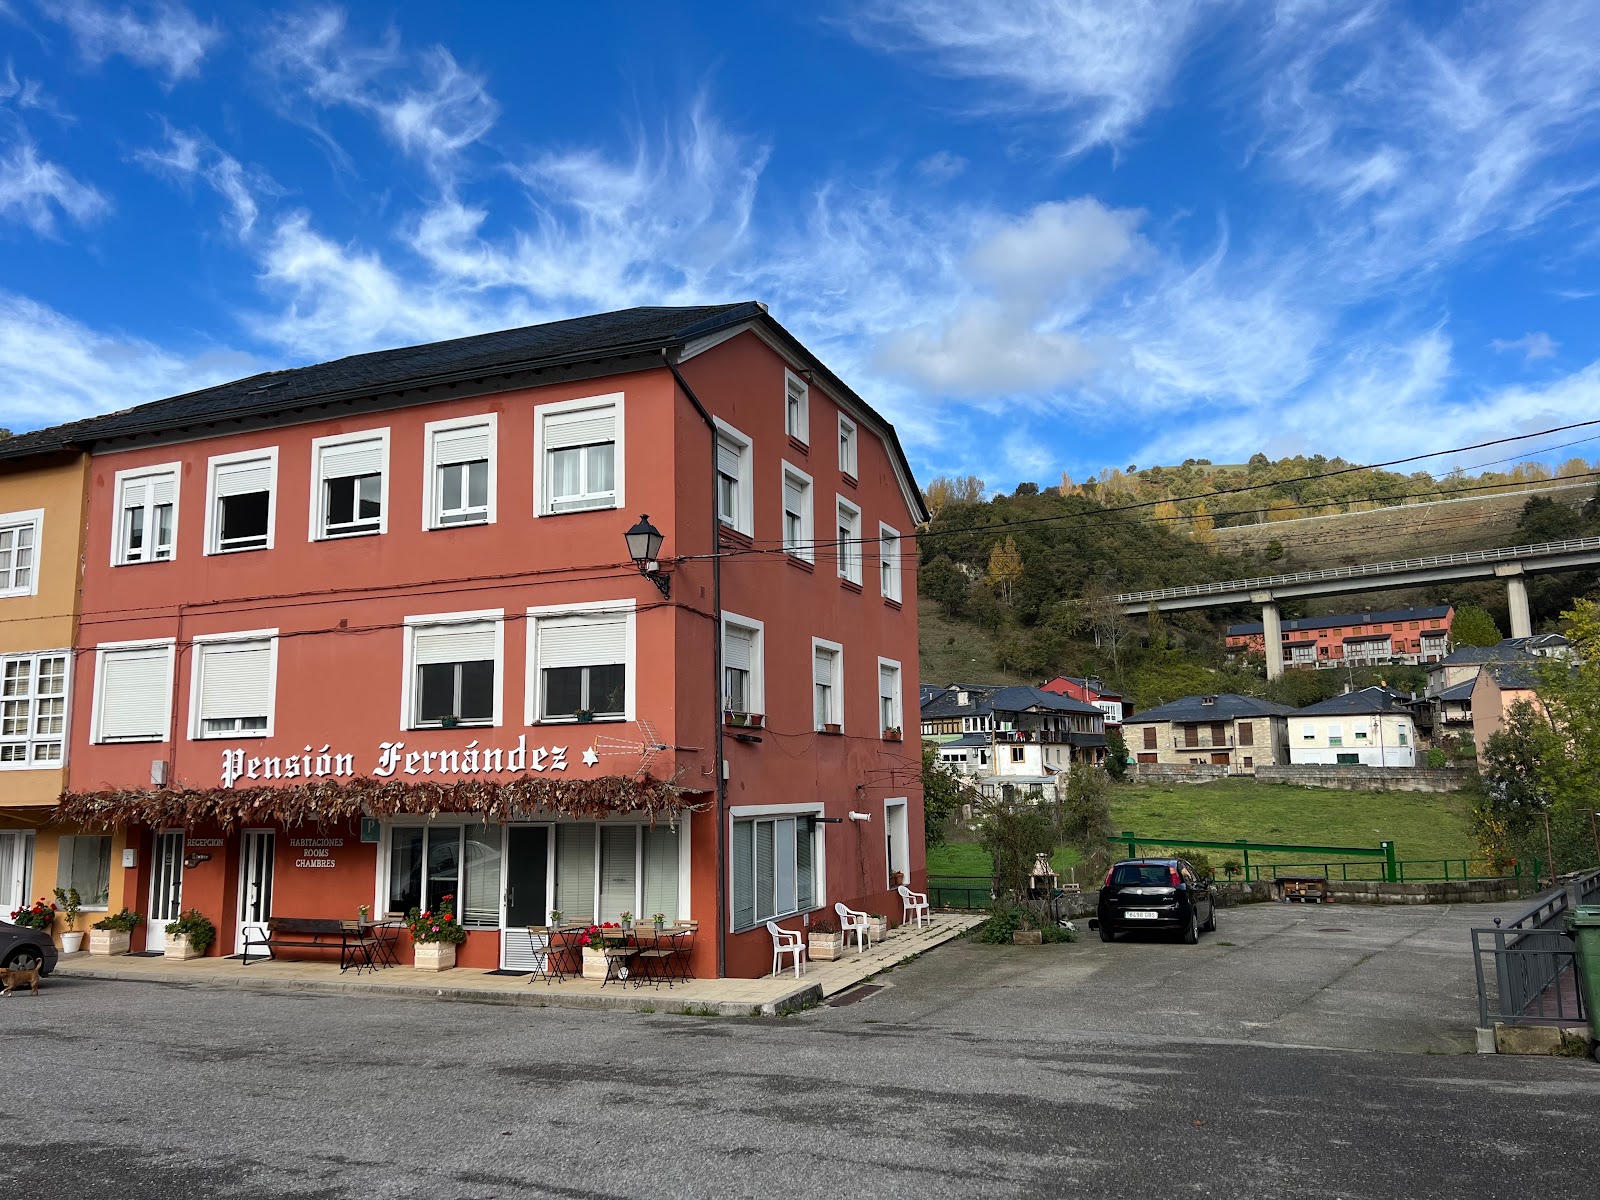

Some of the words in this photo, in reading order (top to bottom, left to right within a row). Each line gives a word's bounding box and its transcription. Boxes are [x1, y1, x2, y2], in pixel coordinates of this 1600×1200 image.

[220, 743, 354, 789] Pensión
[372, 733, 569, 777] Fernández
[187, 838, 224, 847] RECEPCION
[290, 838, 344, 847] HABITACIONES
[303, 848, 329, 857] ROOMS
[295, 859, 336, 868] CHAMBRES
